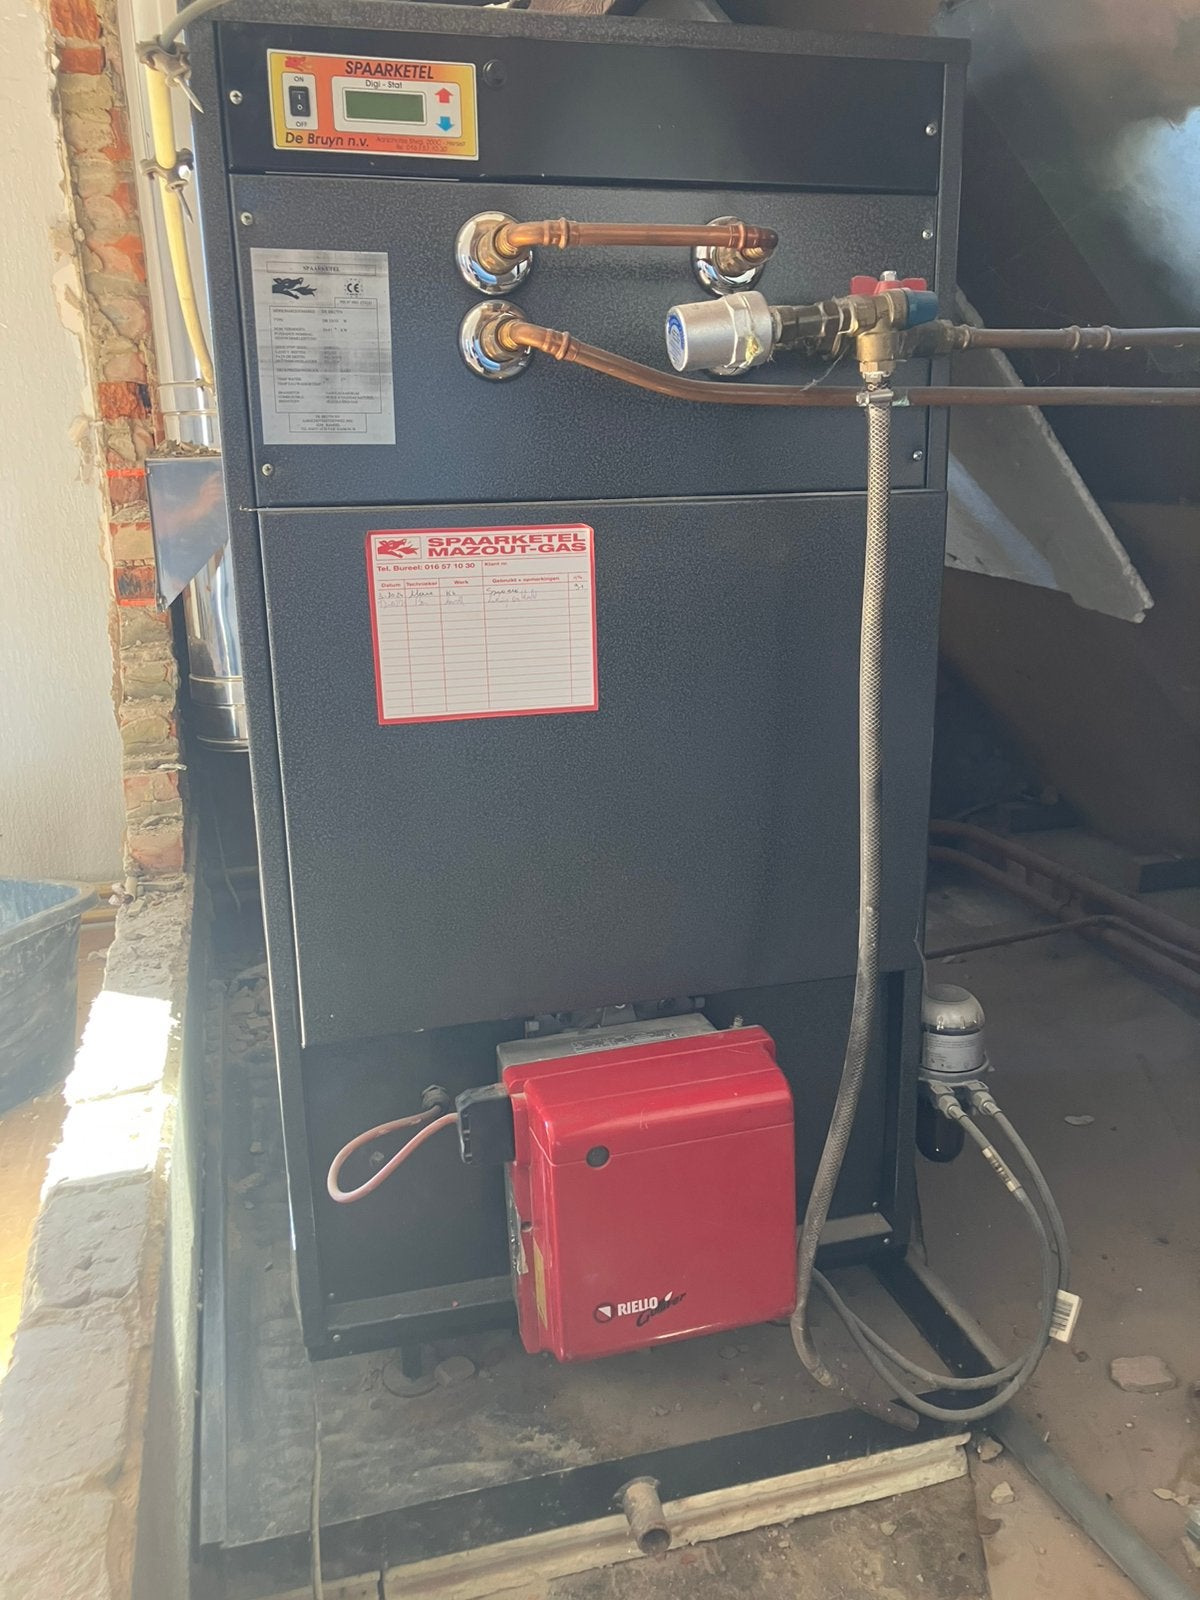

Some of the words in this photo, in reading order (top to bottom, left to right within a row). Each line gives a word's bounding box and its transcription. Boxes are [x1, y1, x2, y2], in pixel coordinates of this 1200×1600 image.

[345, 61, 434, 79] SPAARKETEL
[365, 79, 381, 90] Digi
[387, 80, 403, 88] Stat
[285, 132, 304, 144] De
[308, 133, 344, 147] Bruyn
[348, 137, 369, 147] n.v.
[427, 533, 586, 548] SPAARKETEL
[428, 542, 587, 557] MAZOUT-GAS
[617, 1296, 659, 1316] RIELLO
